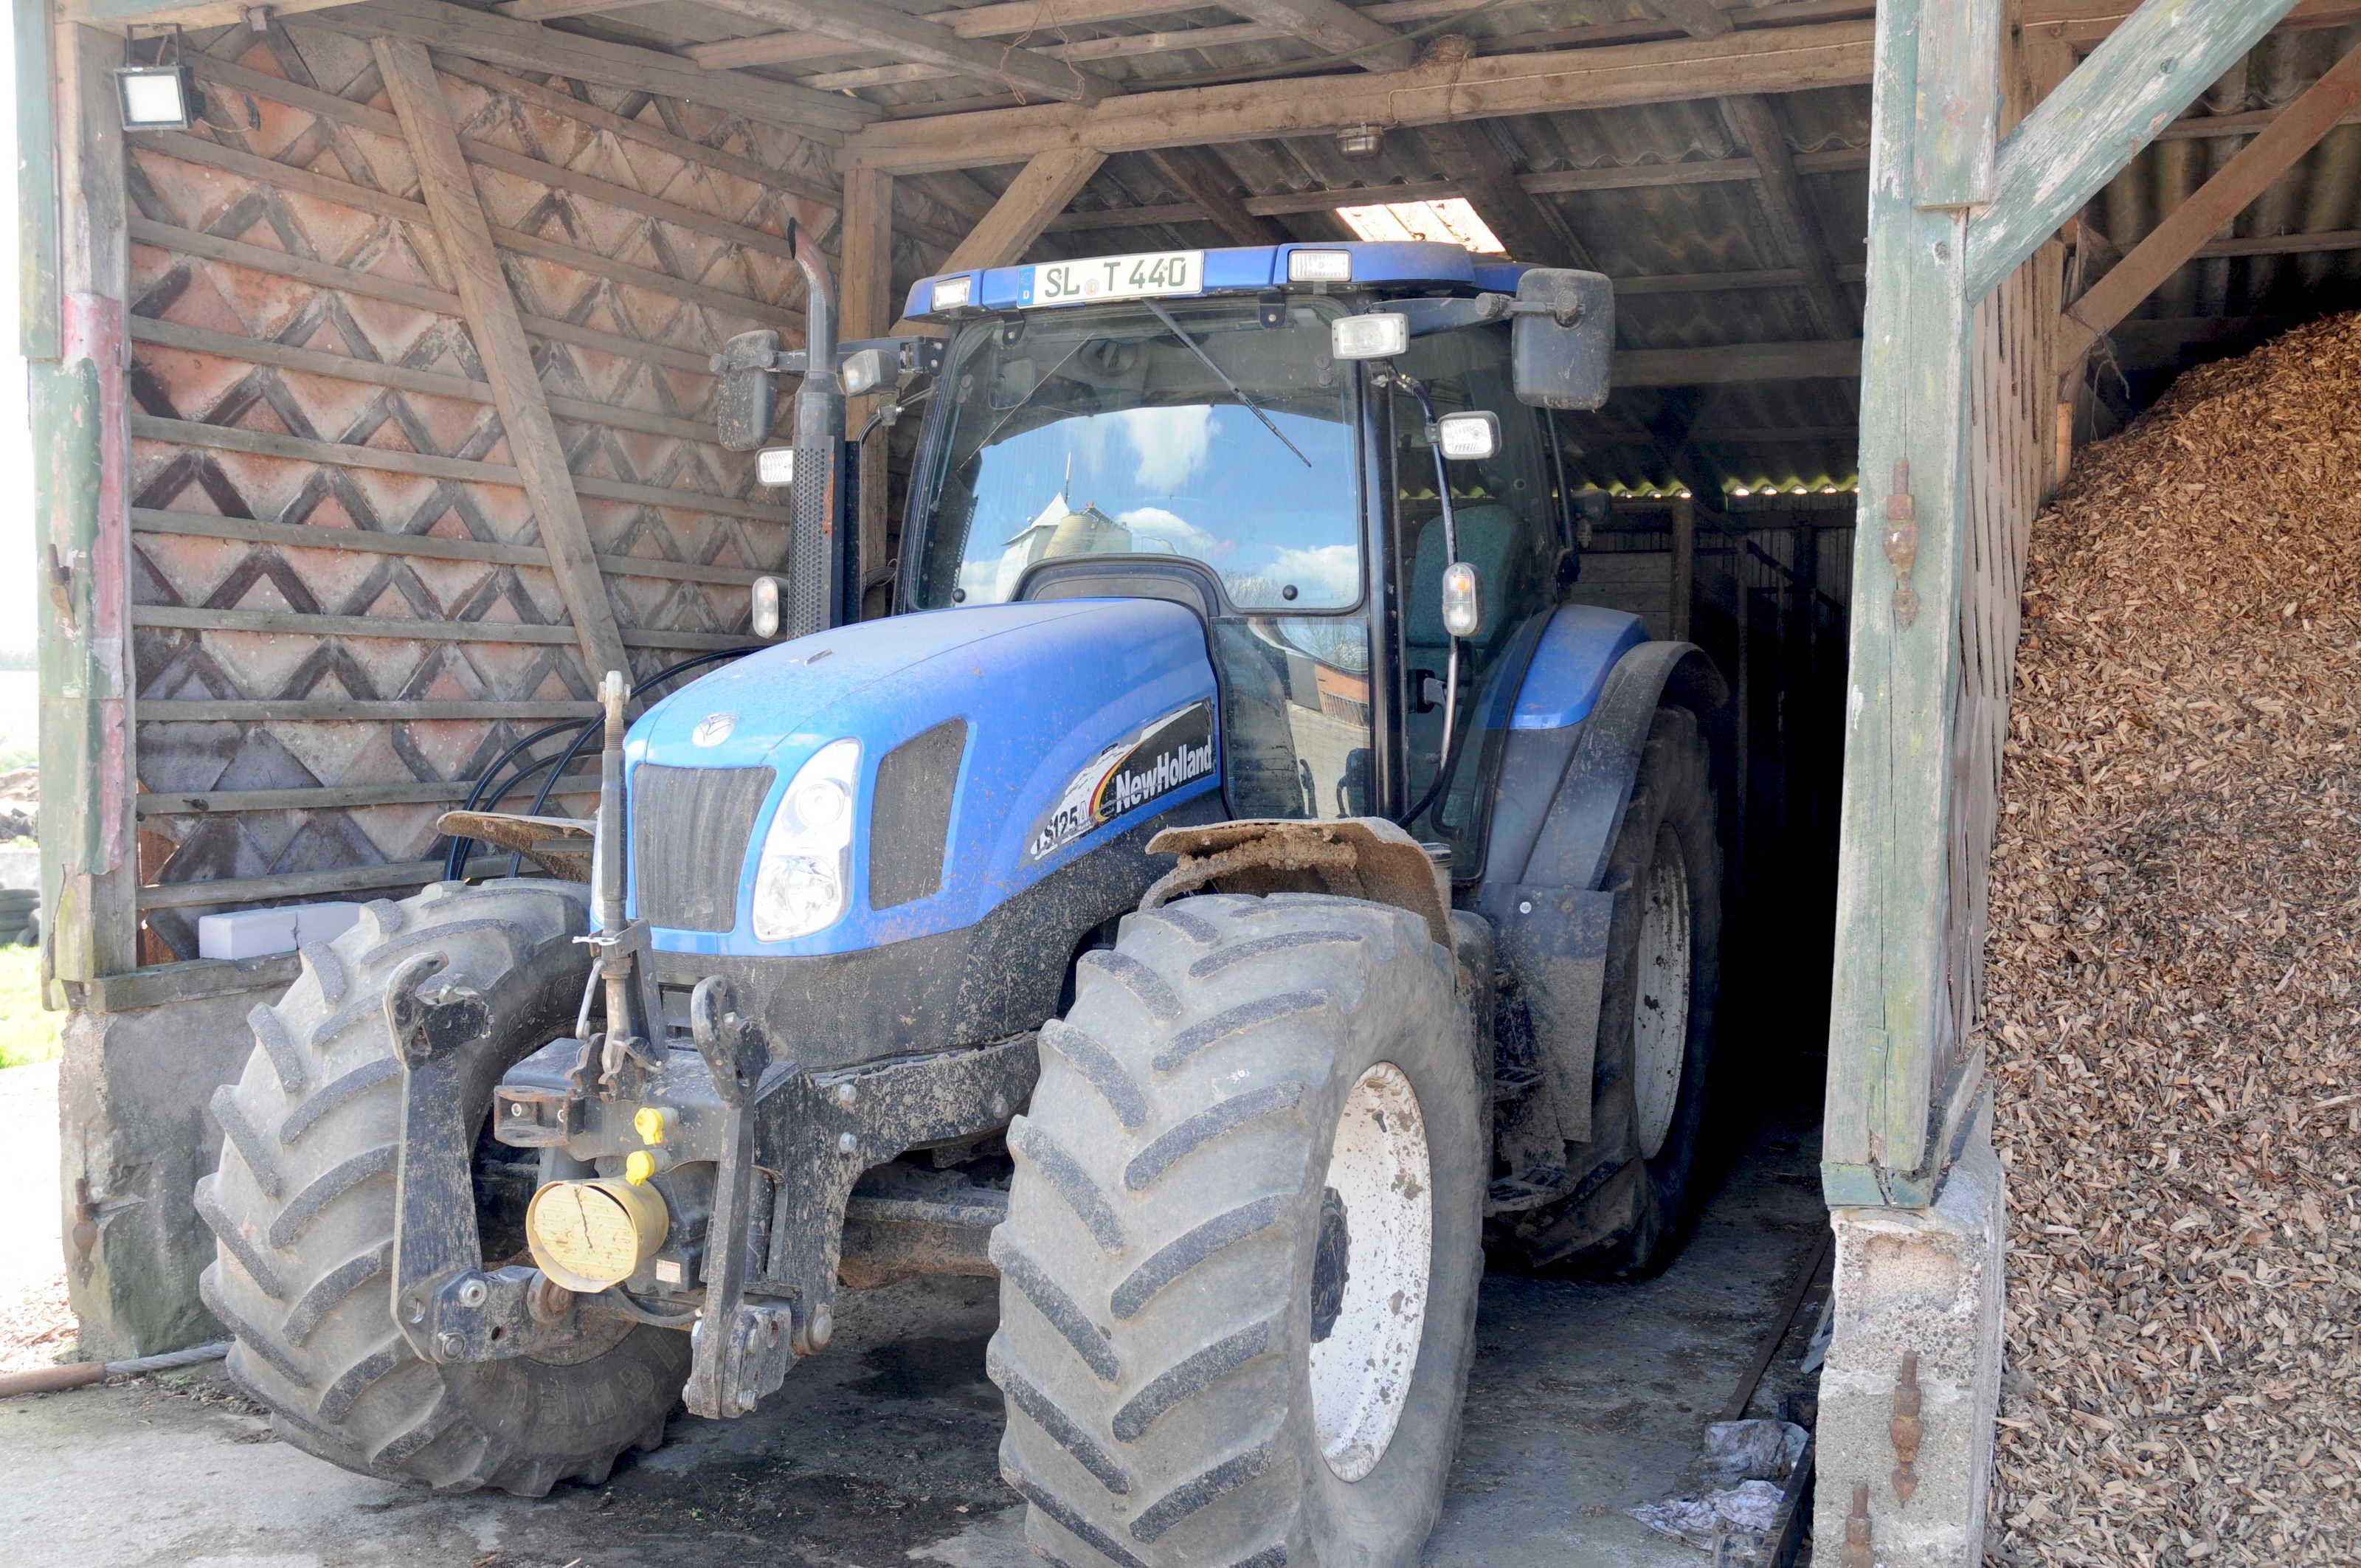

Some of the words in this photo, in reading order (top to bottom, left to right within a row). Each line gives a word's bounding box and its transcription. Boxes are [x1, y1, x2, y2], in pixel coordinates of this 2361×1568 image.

[1045, 266, 1080, 297] SL
[1103, 261, 1121, 291] T
[1129, 257, 1186, 289] 440
[1022, 290, 1030, 300] D
